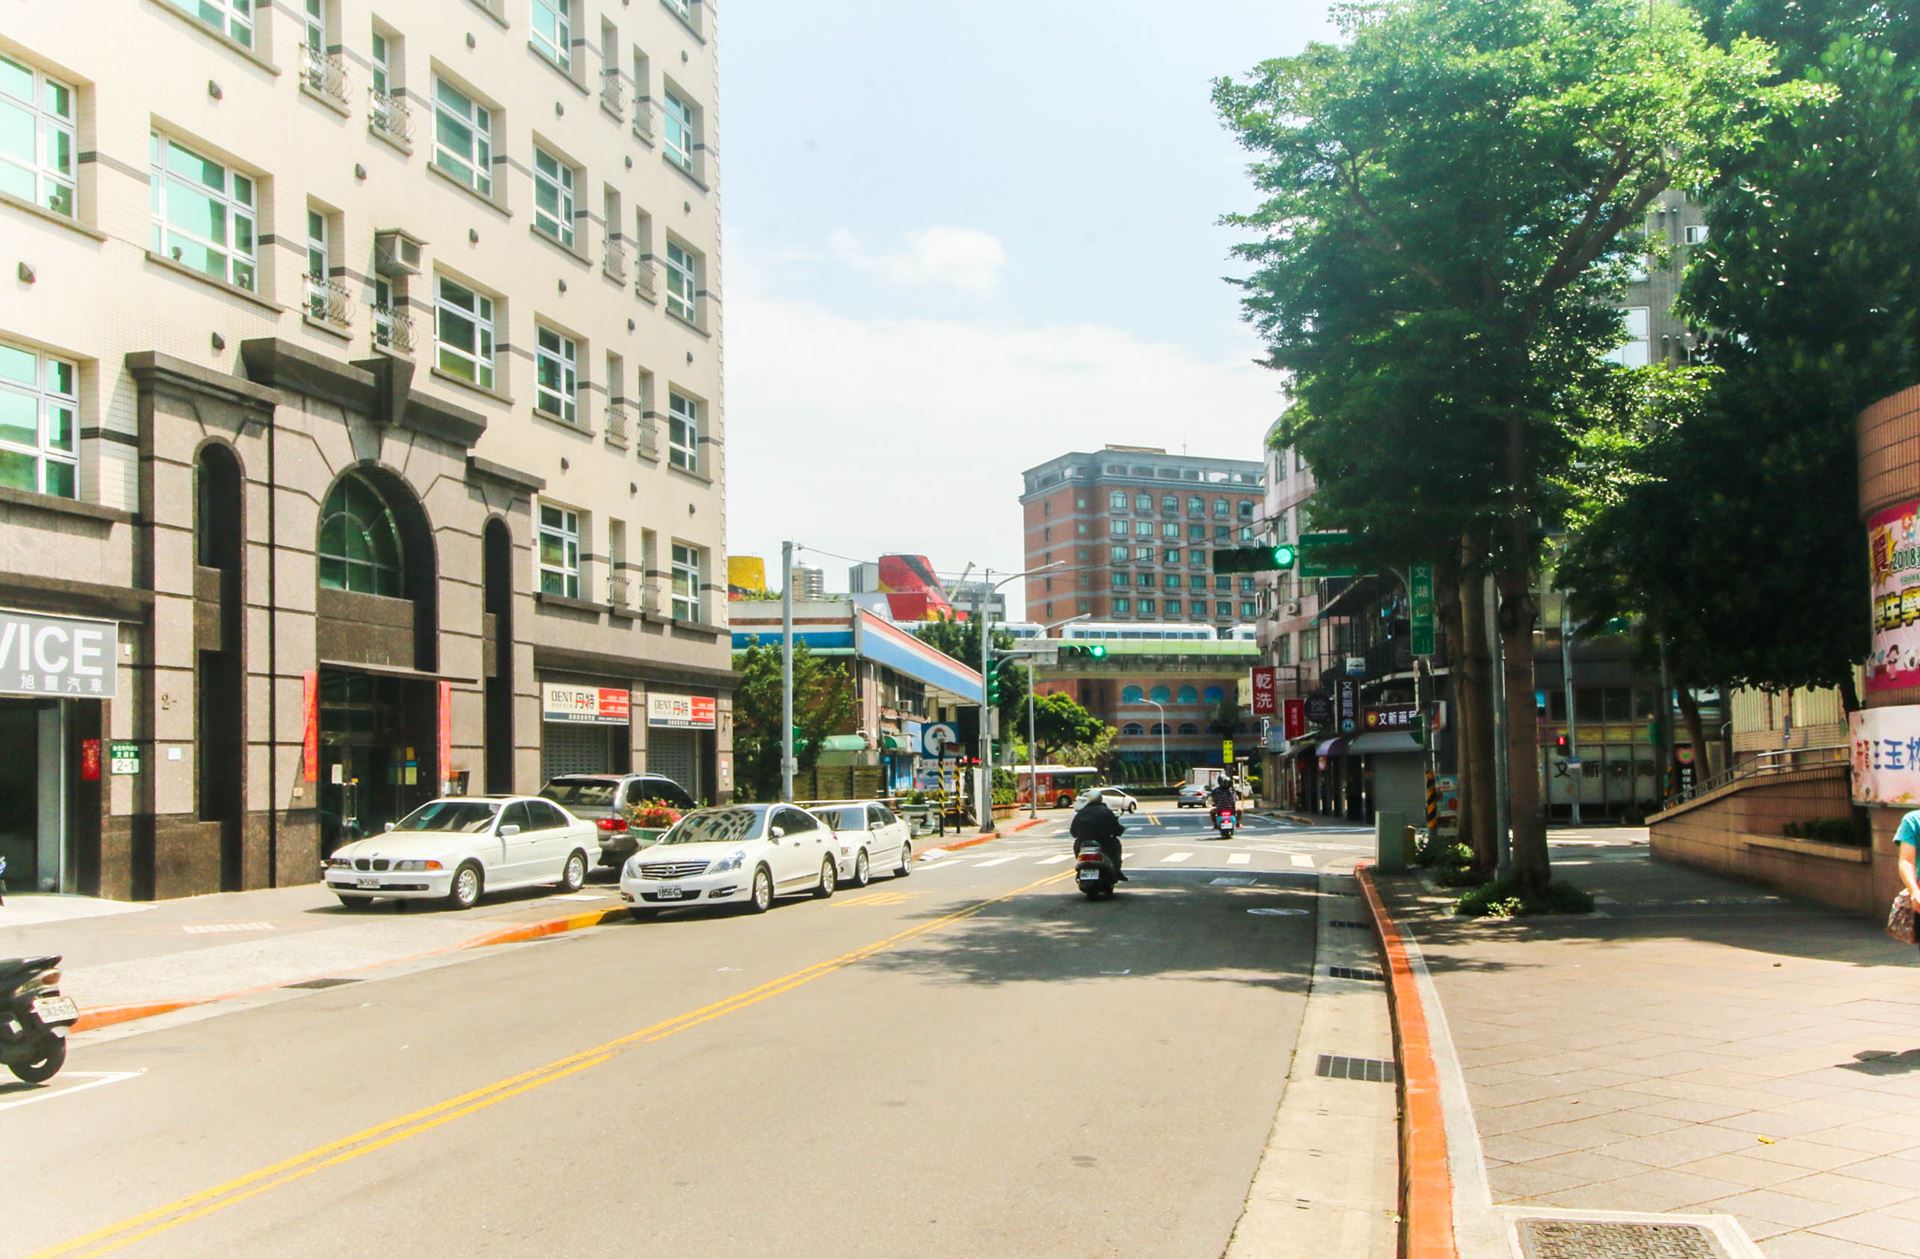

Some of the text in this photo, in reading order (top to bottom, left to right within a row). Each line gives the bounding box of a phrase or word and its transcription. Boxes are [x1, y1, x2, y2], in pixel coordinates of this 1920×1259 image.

[1893, 546, 1920, 570] 2018
[551, 690, 573, 703] DENT
[1255, 673, 1273, 709] 乾洗
[654, 700, 671, 710] DENT
[116, 760, 136, 772] 2-1
